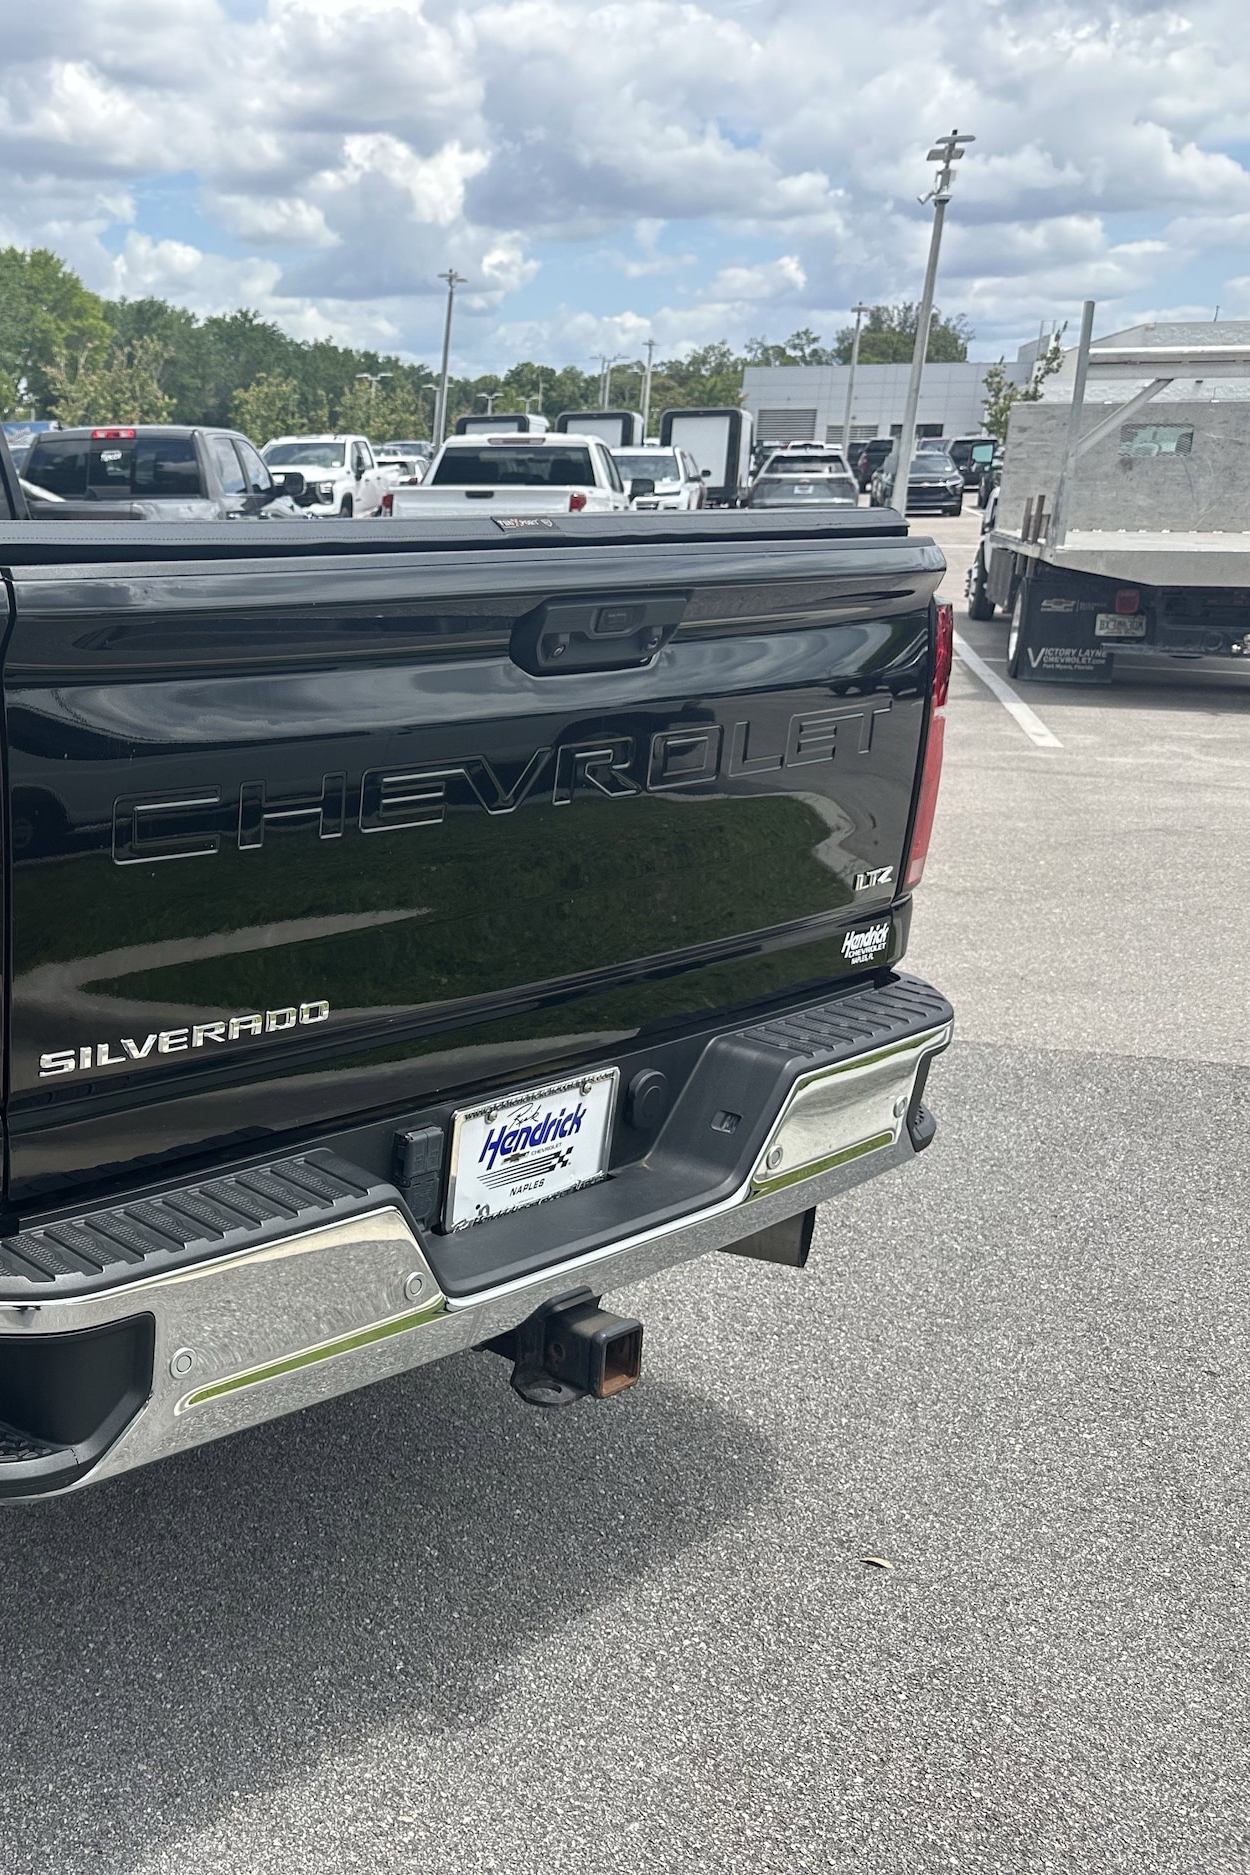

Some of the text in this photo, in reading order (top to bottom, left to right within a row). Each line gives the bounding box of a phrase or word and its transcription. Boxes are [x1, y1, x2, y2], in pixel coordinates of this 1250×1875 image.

[1027, 647, 1107, 668] VICTORY LAYNE
[111, 700, 892, 866] CHEVROLET
[854, 865, 893, 891] LTZ
[841, 922, 889, 958] Hendrick
[849, 942, 887, 958] CHEVROLET
[38, 1000, 330, 1078] SILVERADO
[478, 1102, 588, 1171] Hendrick
[531, 1142, 562, 1156] CHEVROLET
[509, 1178, 545, 1197] NAPLES
